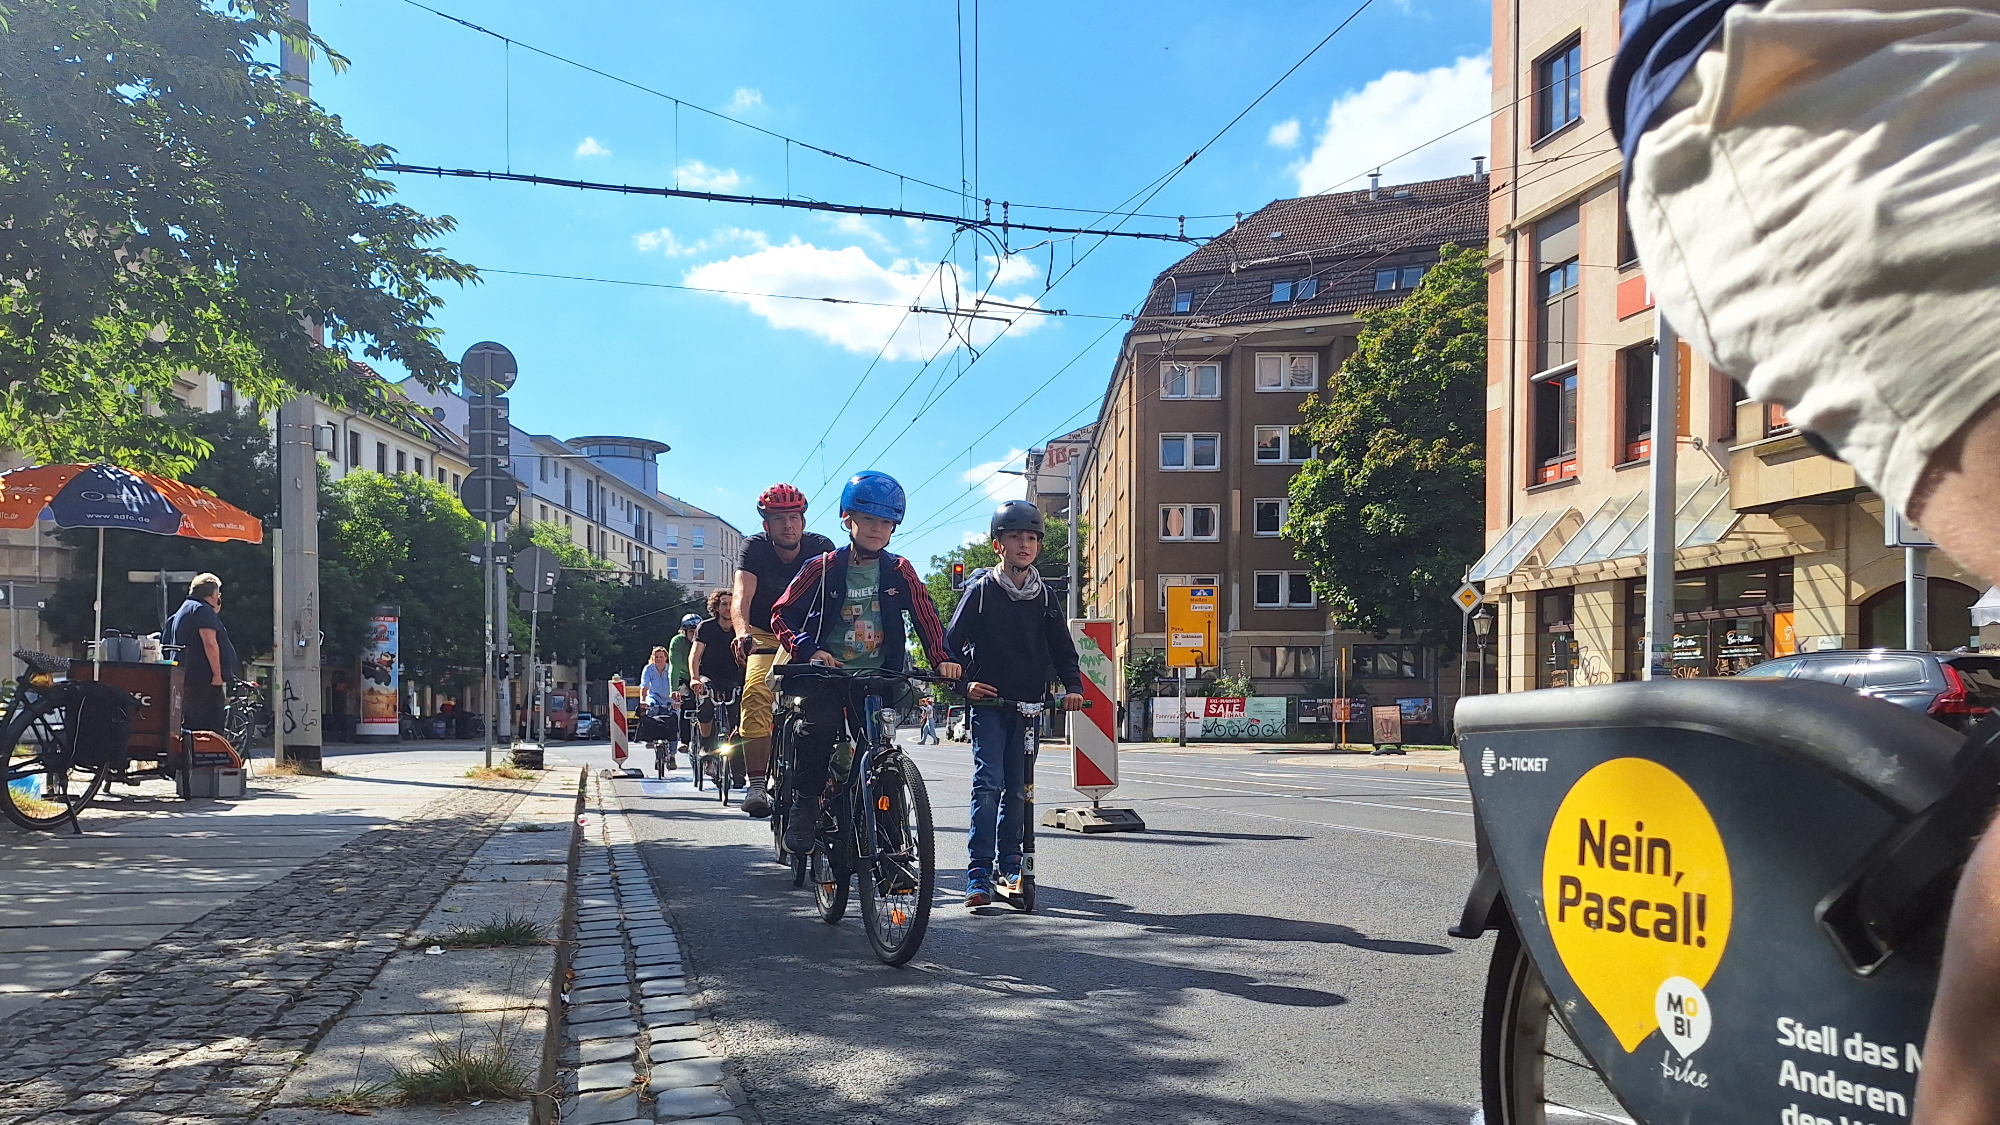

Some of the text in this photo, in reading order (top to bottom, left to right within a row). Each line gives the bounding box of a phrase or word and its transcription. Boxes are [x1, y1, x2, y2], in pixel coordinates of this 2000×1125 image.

[86, 512, 150, 523] www.adfc.de
[1208, 704, 1240, 714] SALE
[1499, 757, 1549, 772] D-TICKET
[1577, 818, 1684, 887] Nein,
[1558, 875, 1707, 948] Pascal!
[1666, 992, 1698, 1017] MO
[1674, 1015, 1691, 1039] BI
[1776, 1016, 1838, 1057] Stell
[1843, 1032, 1899, 1070] das
[1659, 1050, 1709, 1089] bike
[1778, 1059, 1907, 1117] Anderen
